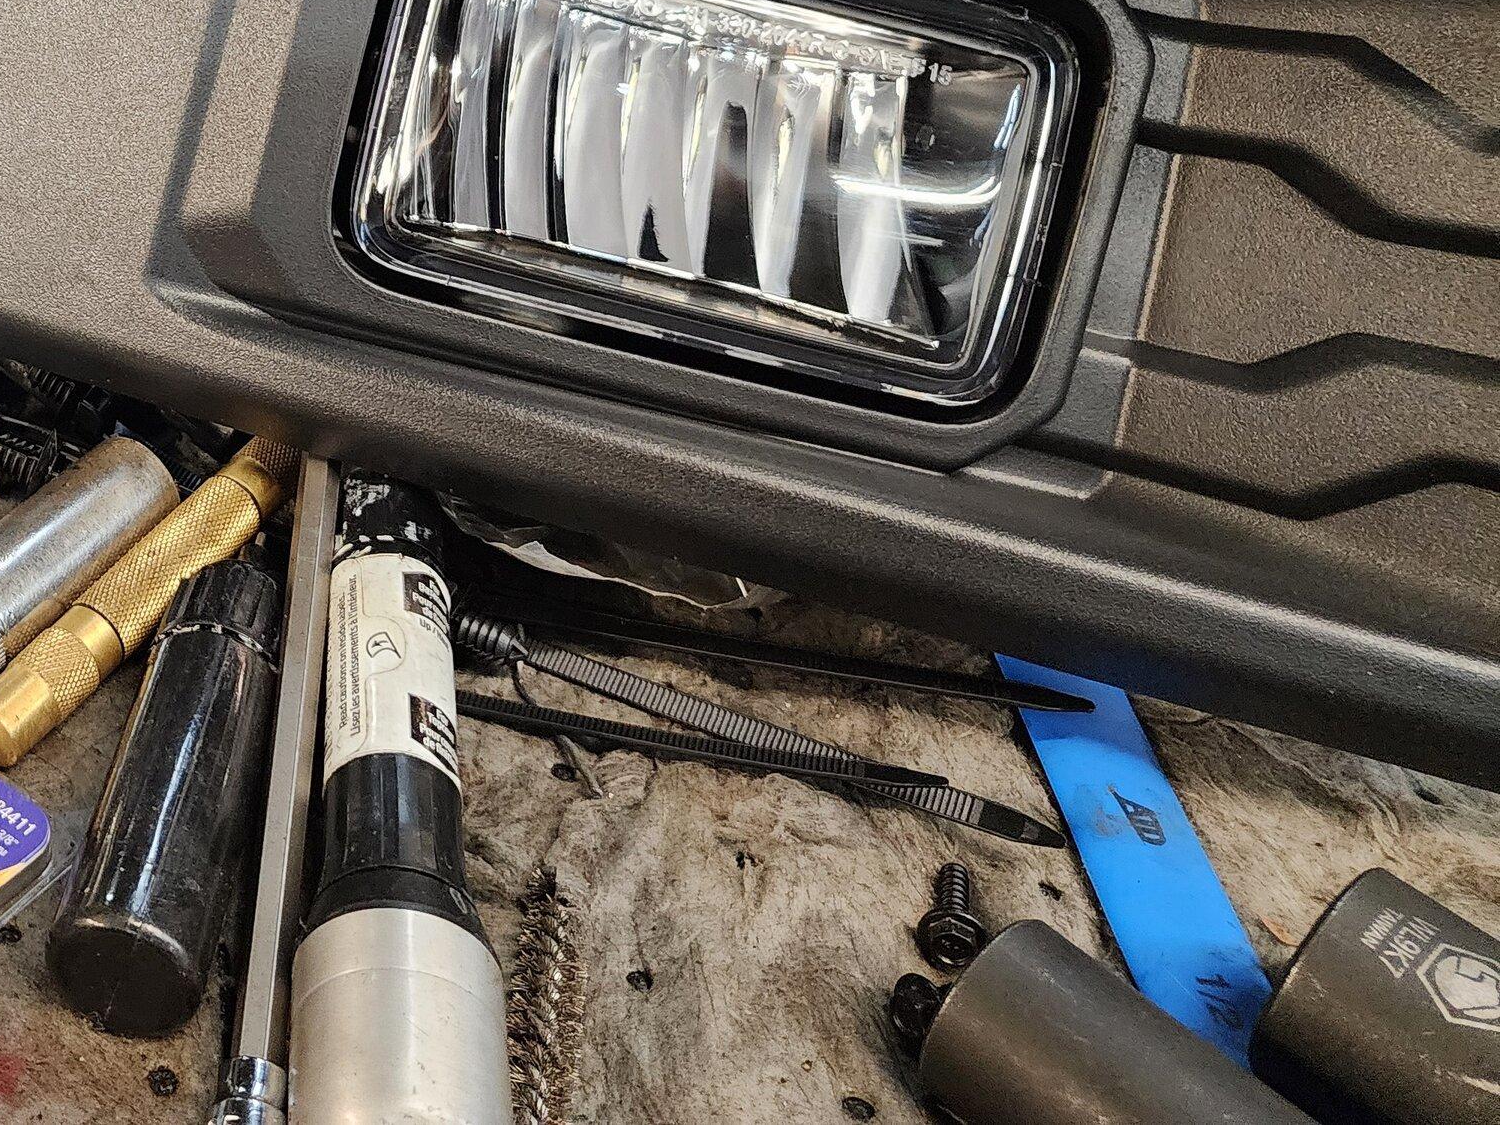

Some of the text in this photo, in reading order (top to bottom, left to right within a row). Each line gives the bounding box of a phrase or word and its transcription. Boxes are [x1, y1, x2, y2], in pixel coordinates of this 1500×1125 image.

[338, 702, 348, 731] Read
[1113, 790, 1167, 846] ATD
[1358, 906, 1405, 951] TAIWAN
